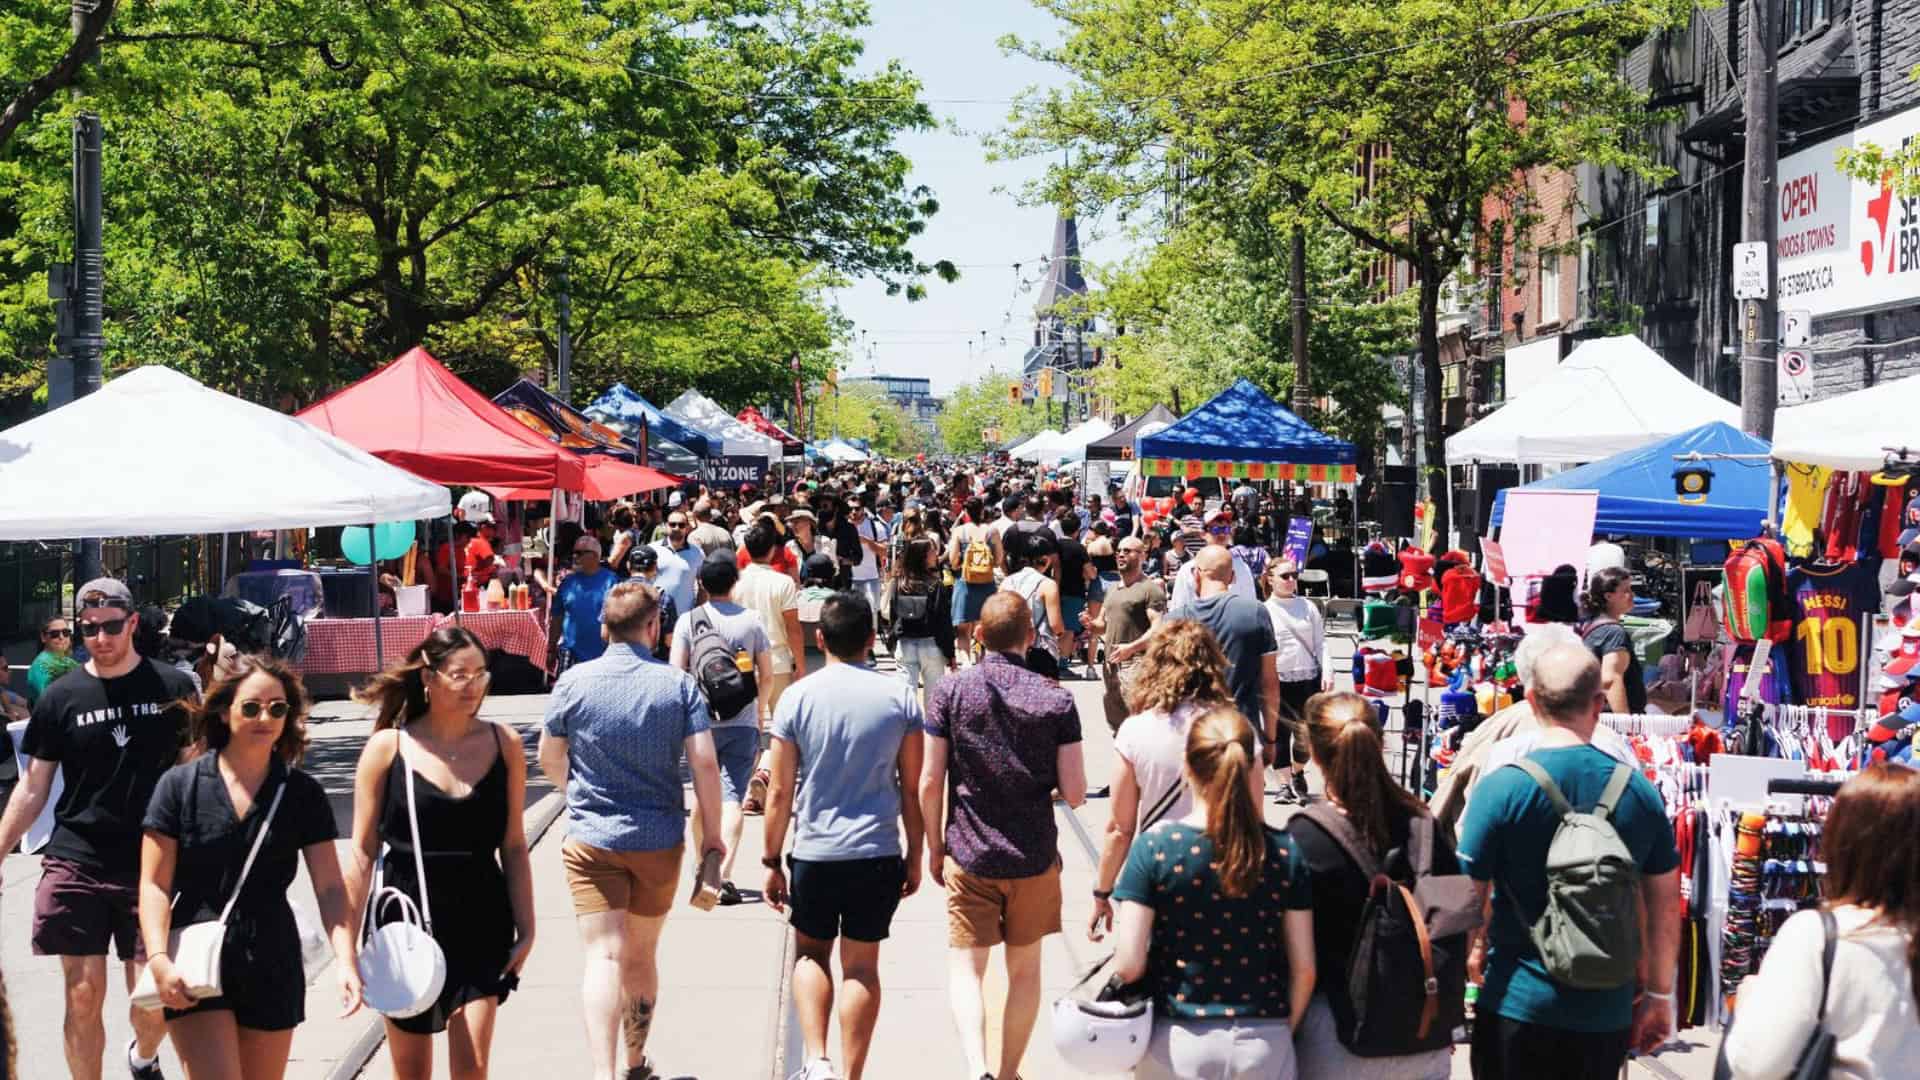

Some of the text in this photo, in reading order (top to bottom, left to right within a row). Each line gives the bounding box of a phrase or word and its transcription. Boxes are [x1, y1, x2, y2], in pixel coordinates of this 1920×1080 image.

[1782, 171, 1818, 222] OPEN
[1901, 194, 1920, 227] SE
[1777, 233, 1799, 257] NDOS
[1807, 223, 1835, 252] TOWNS
[1900, 227, 1920, 272] BR
[719, 466, 760, 481] ZONE
[1803, 594, 1847, 610] MESSI
[1797, 616, 1858, 674] 10
[76, 703, 161, 728] KAWHI THO
